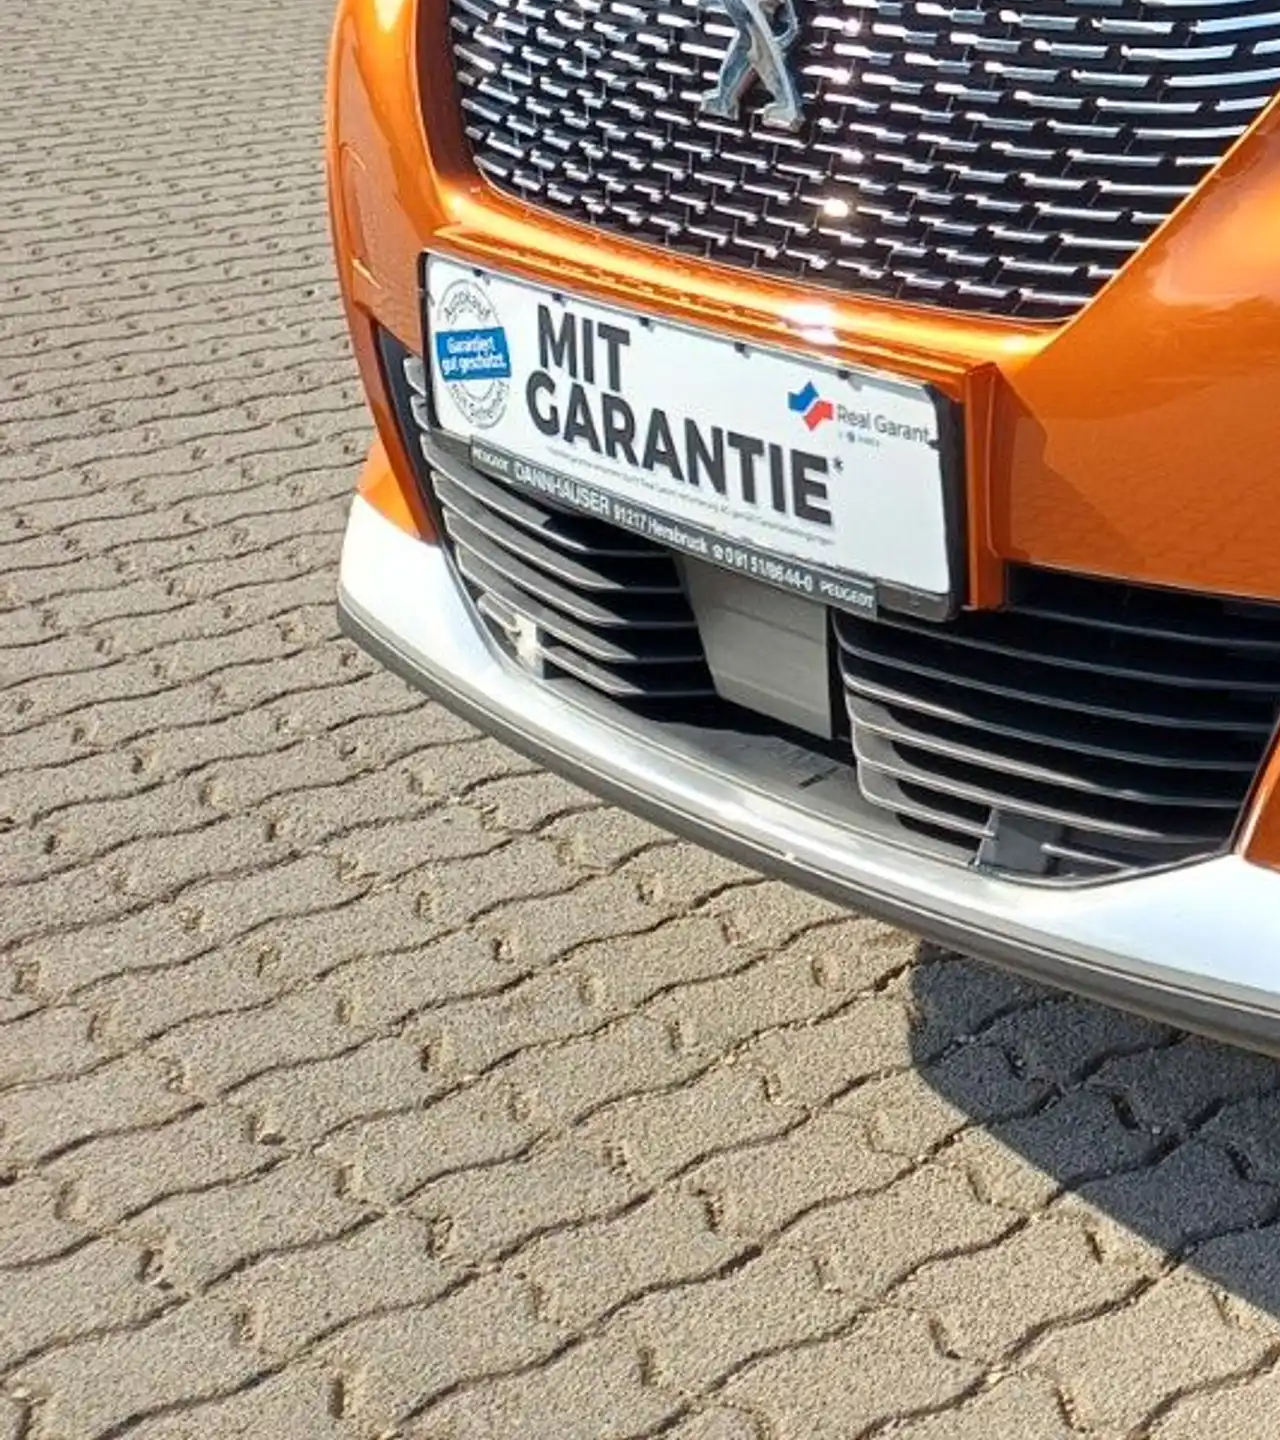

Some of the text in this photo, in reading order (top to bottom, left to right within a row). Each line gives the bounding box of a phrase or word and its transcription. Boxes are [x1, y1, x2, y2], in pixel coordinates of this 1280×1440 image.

[537, 303, 631, 392] MIT
[837, 403, 871, 430] Real
[873, 414, 930, 444] Garant
[819, 580, 875, 609] PEUGEOT
